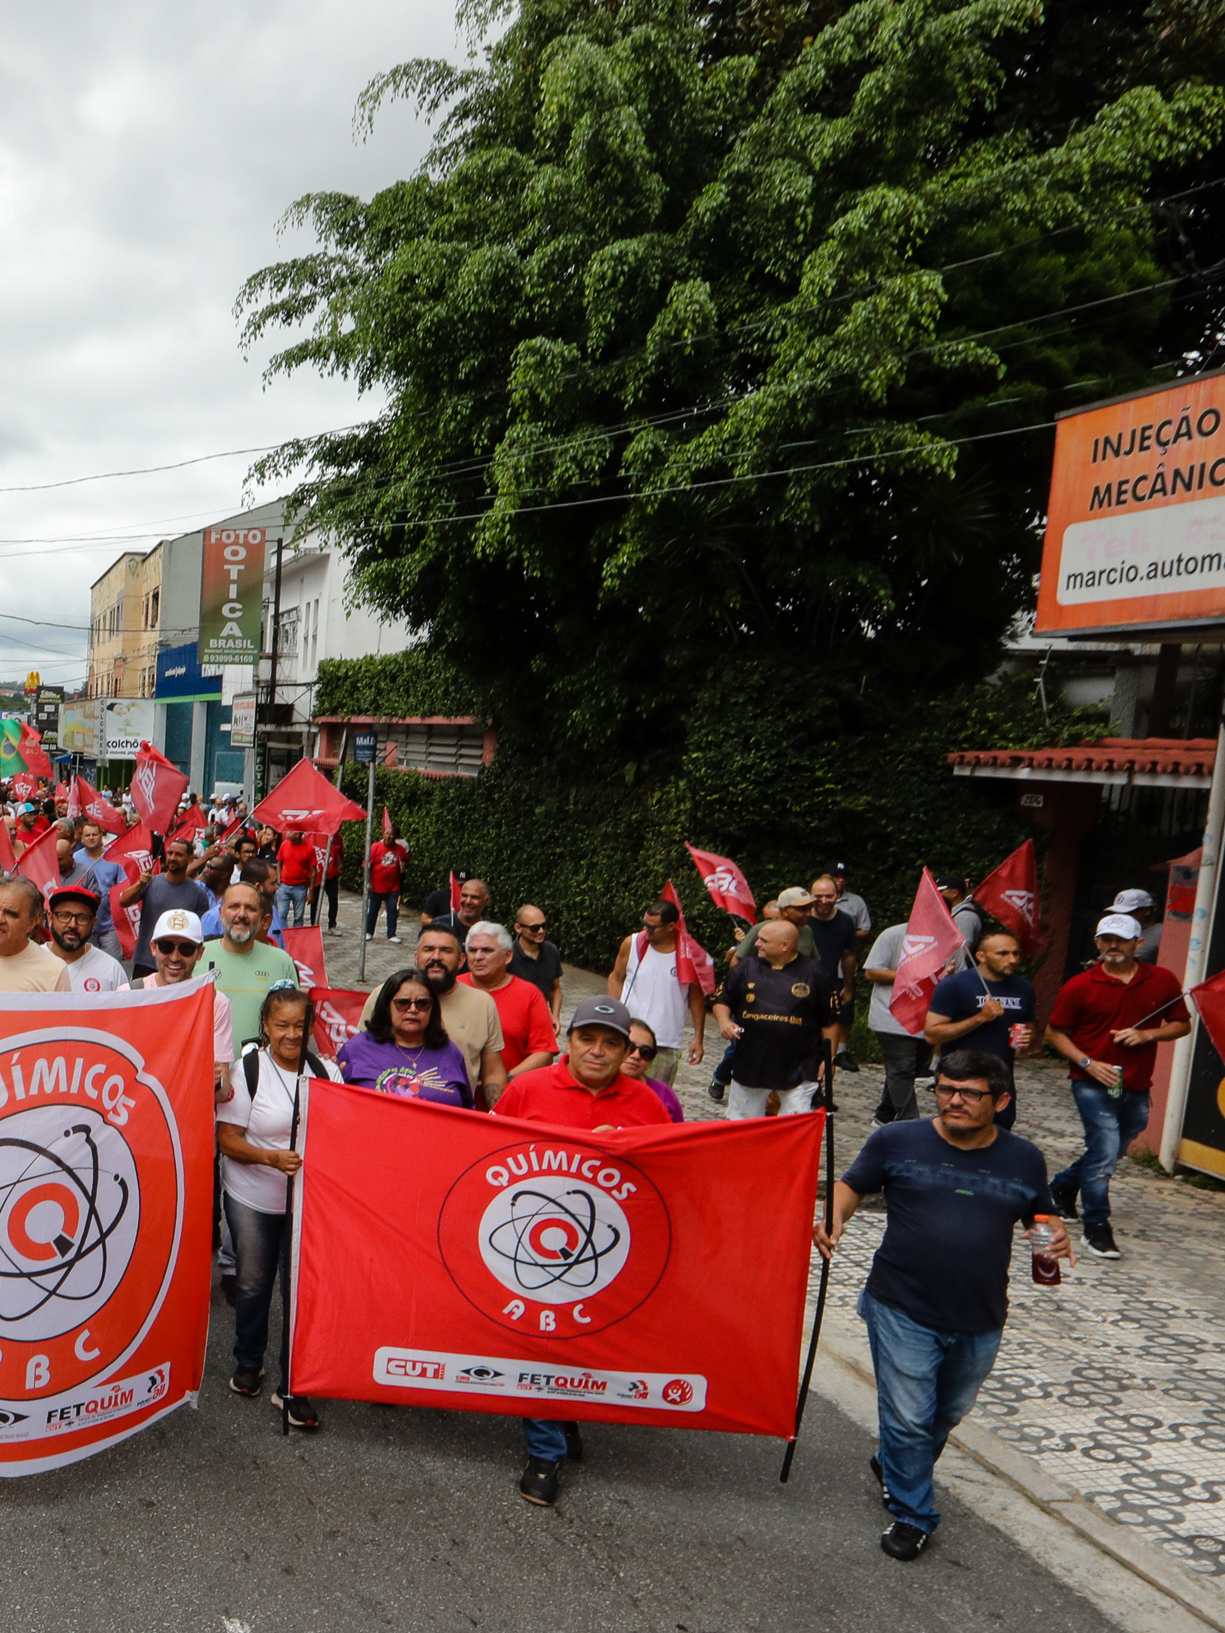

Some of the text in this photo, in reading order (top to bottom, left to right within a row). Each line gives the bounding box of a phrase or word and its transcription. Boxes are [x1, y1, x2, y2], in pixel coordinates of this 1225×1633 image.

[1091, 405, 1221, 464] INJEÇÃO
[210, 529, 262, 544] FOTO
[1066, 552, 1225, 591] marcio.autom
[219, 545, 247, 637] OTICA
[209, 638, 255, 649] BRASIL
[106, 738, 151, 749] colchõ
[485, 1144, 638, 1201] QUÍMICOS
[387, 1359, 440, 1379] CUT
